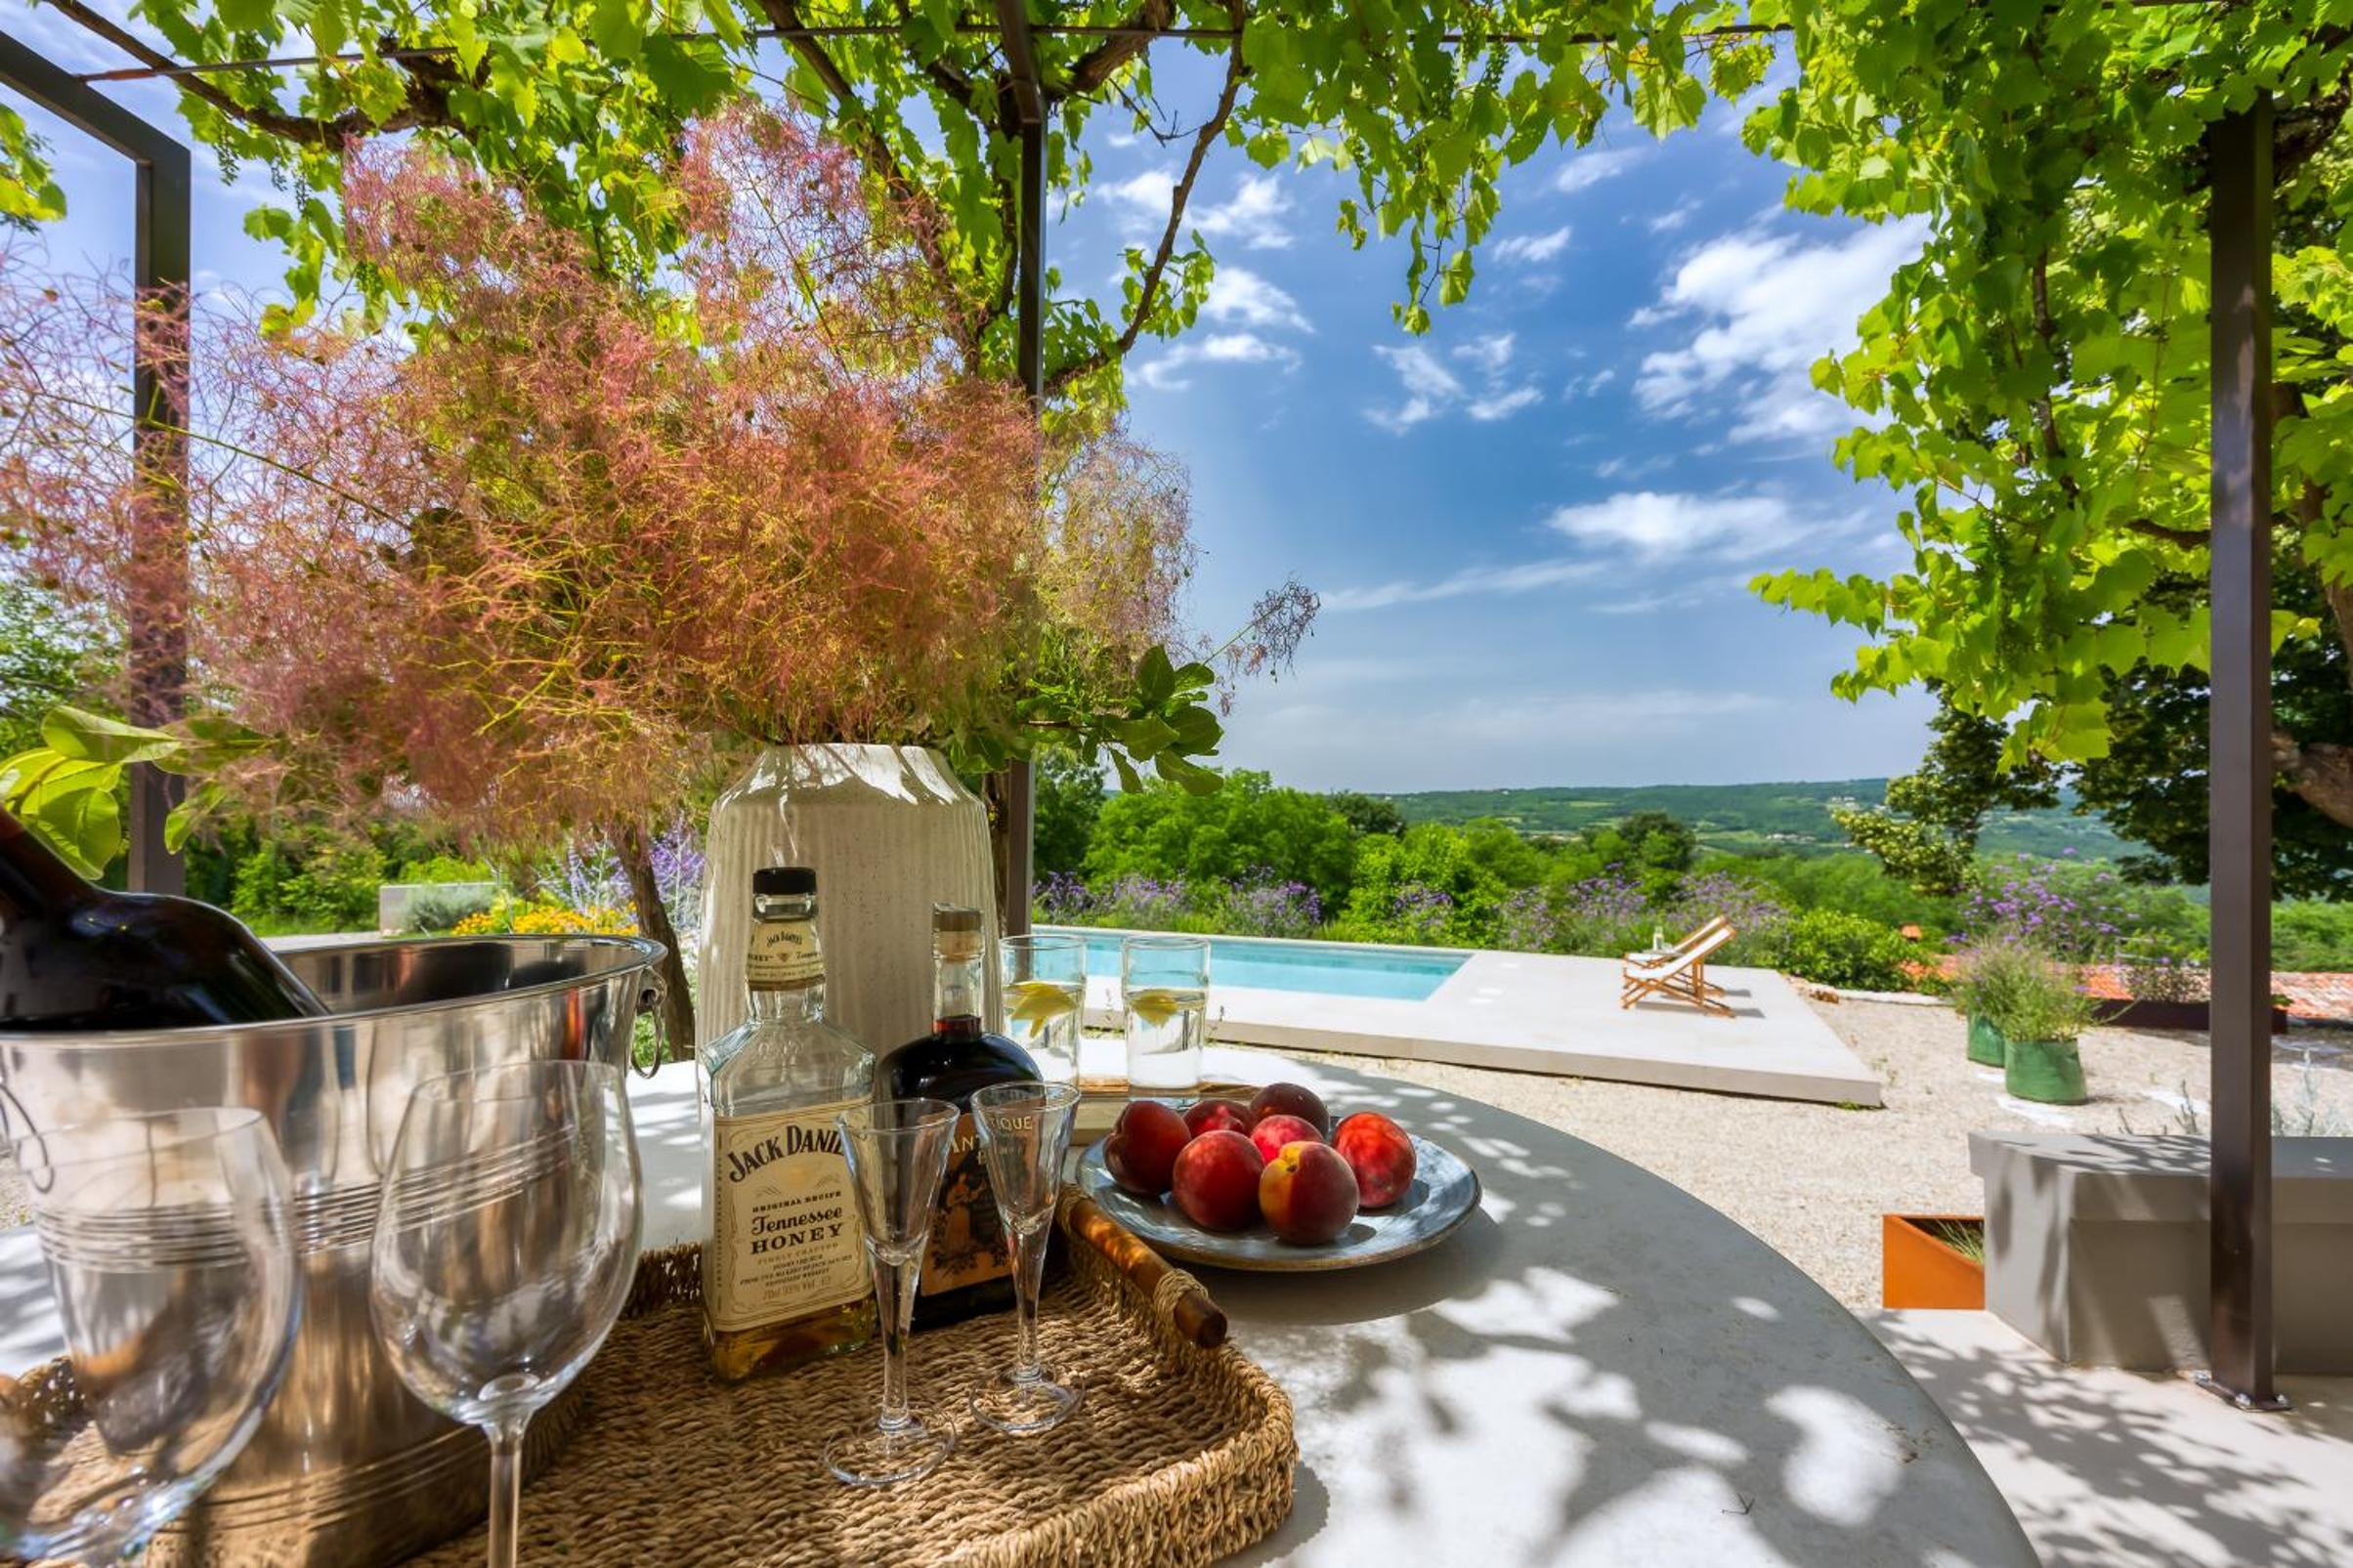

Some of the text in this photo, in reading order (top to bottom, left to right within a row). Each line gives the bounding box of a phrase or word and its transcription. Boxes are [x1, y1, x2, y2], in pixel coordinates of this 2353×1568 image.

[727, 1136, 785, 1183] JACK
[752, 1191, 841, 1213] ORIGINAL RECIPE
[750, 1207, 842, 1236] Tennessee
[749, 1221, 843, 1255] HONEY
